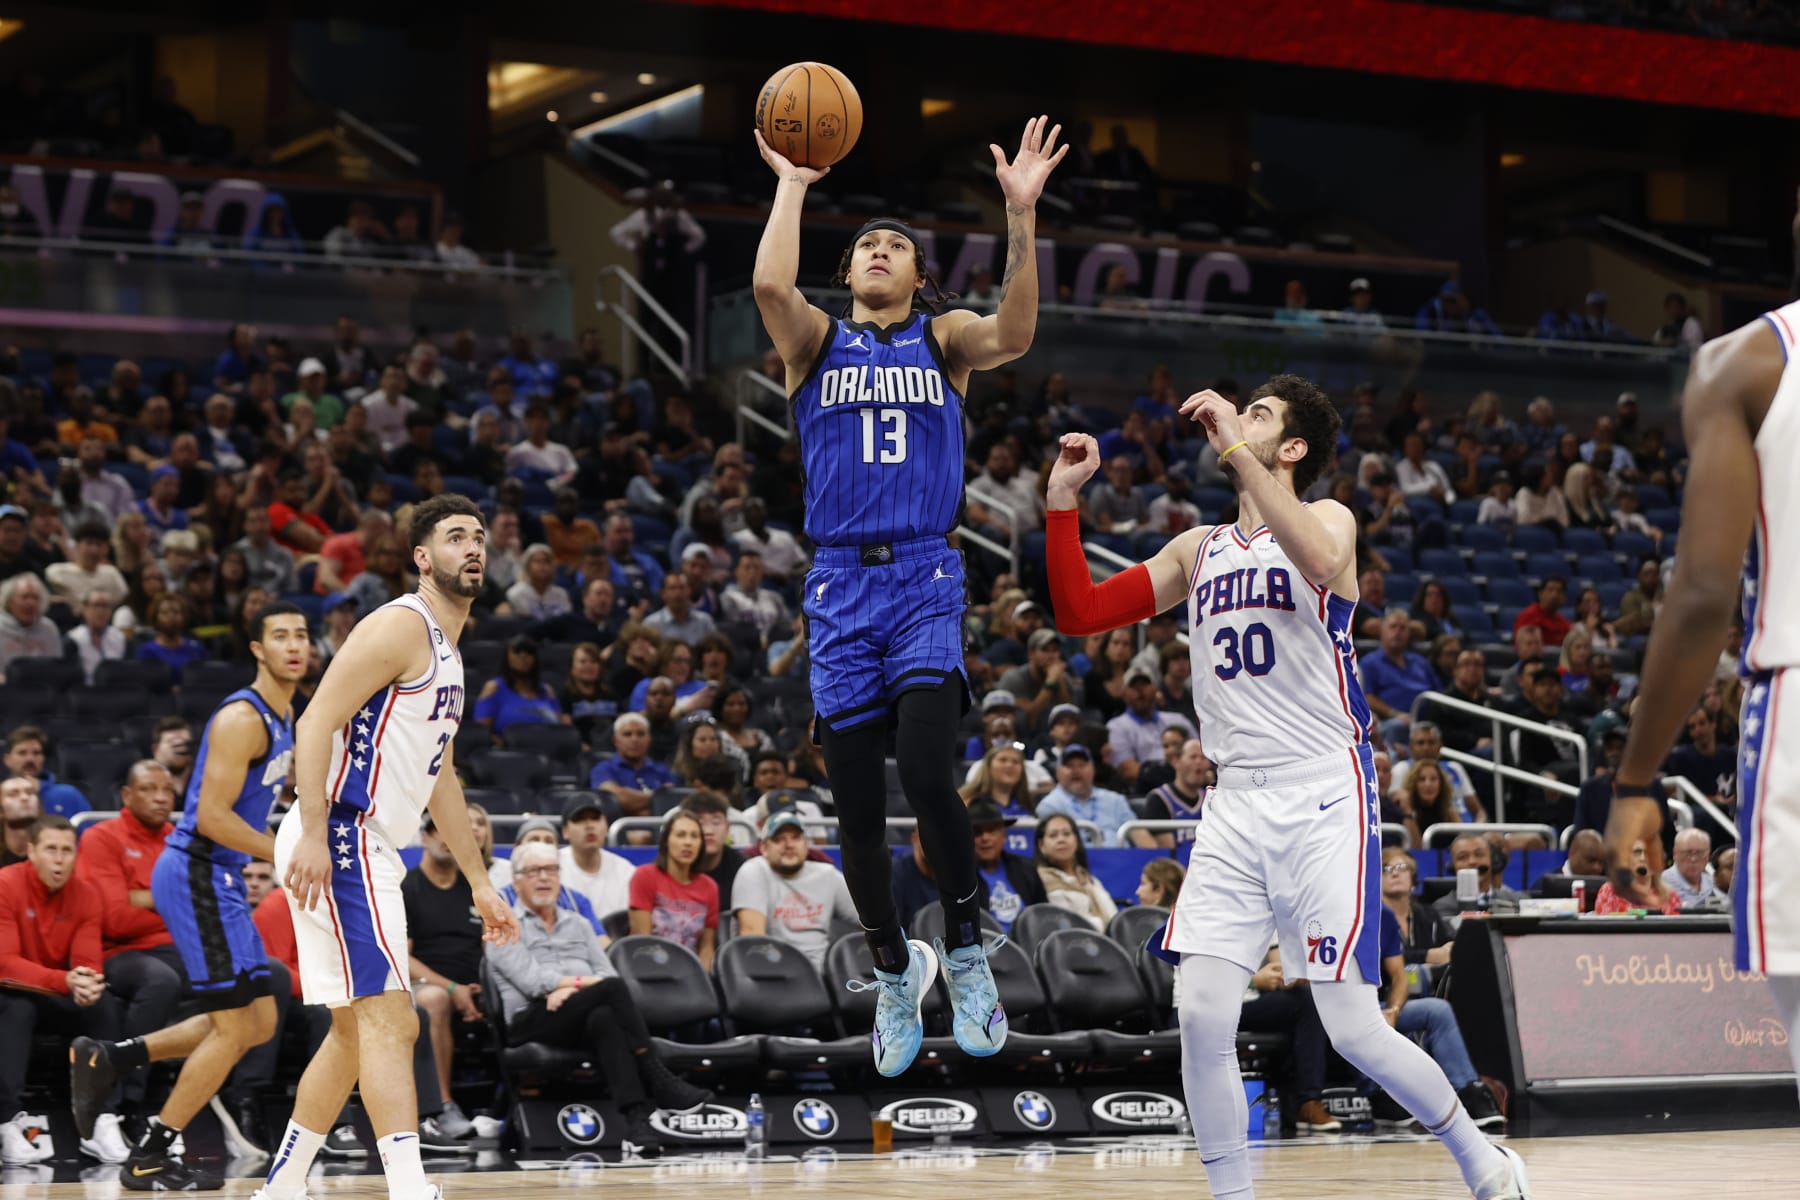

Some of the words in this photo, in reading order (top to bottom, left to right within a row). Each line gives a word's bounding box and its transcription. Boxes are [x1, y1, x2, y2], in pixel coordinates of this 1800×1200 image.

[820, 364, 945, 408] ORLANDO
[859, 407, 907, 464] 13
[1195, 566, 1297, 628] PHILA
[1212, 621, 1276, 681] 30
[427, 732, 450, 776] 2
[1306, 935, 1338, 966] 76
[1575, 953, 1715, 993] Holiday
[668, 1113, 734, 1130] FIELDS
[898, 1107, 961, 1126] FIELDS
[1110, 1101, 1170, 1118] FIELDS
